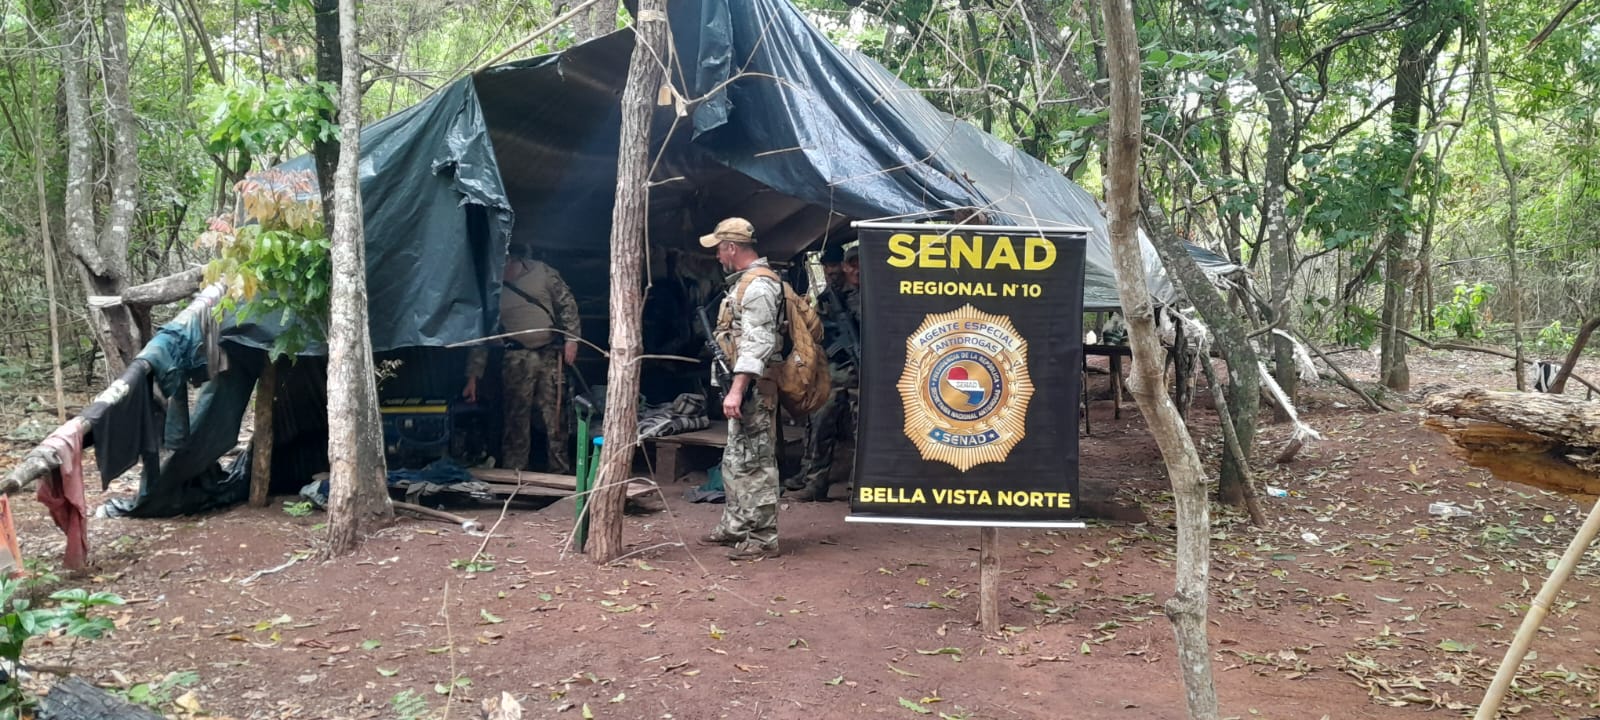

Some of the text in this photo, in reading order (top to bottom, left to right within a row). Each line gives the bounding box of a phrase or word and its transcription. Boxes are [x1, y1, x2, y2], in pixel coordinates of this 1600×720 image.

[887, 233, 1057, 271] SENAD
[899, 281, 997, 297] REGIONAL
[1021, 283, 1042, 298] 10
[919, 321, 1014, 348] AGENTE ESPECIAL
[935, 336, 999, 353] ANTIDROGAS
[970, 352, 978, 360] LA
[941, 432, 987, 446] SENAD
[859, 486, 1071, 509] BELLA VISTA NORTE
